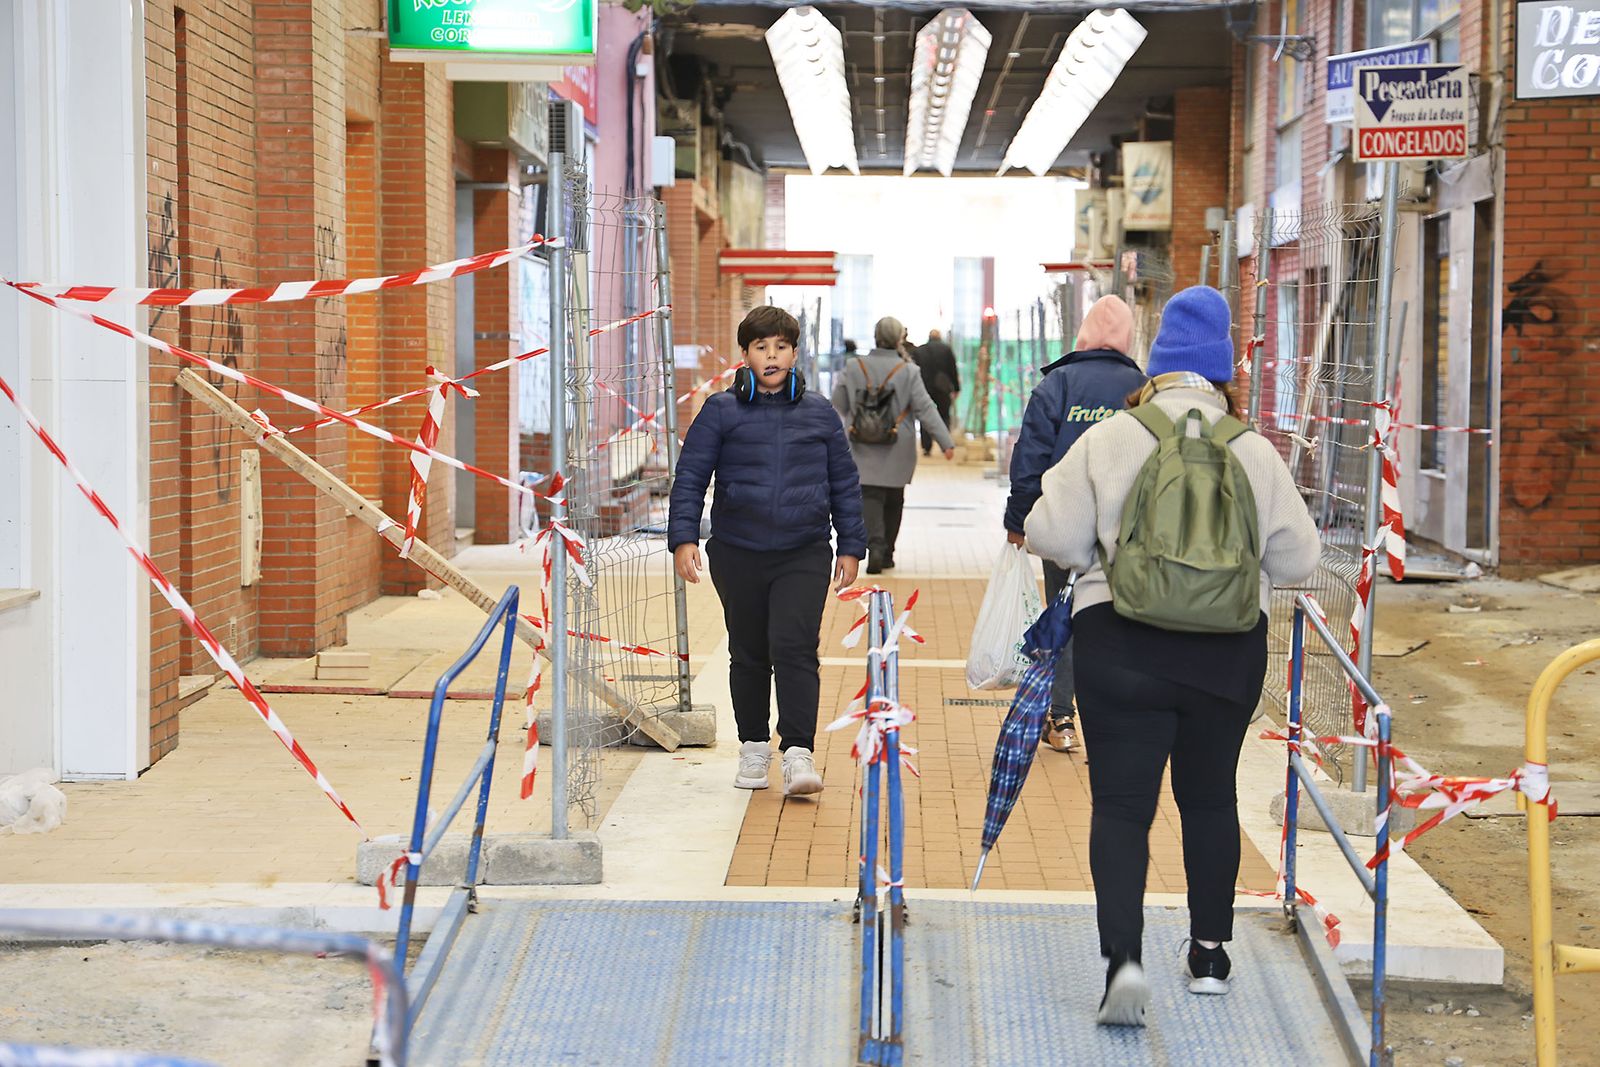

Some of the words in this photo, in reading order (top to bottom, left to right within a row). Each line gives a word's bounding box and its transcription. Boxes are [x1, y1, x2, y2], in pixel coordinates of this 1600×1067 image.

[1531, 49, 1600, 90] CO
[1362, 129, 1464, 155] CONGELADOS
[1067, 405, 1121, 422] Frute
